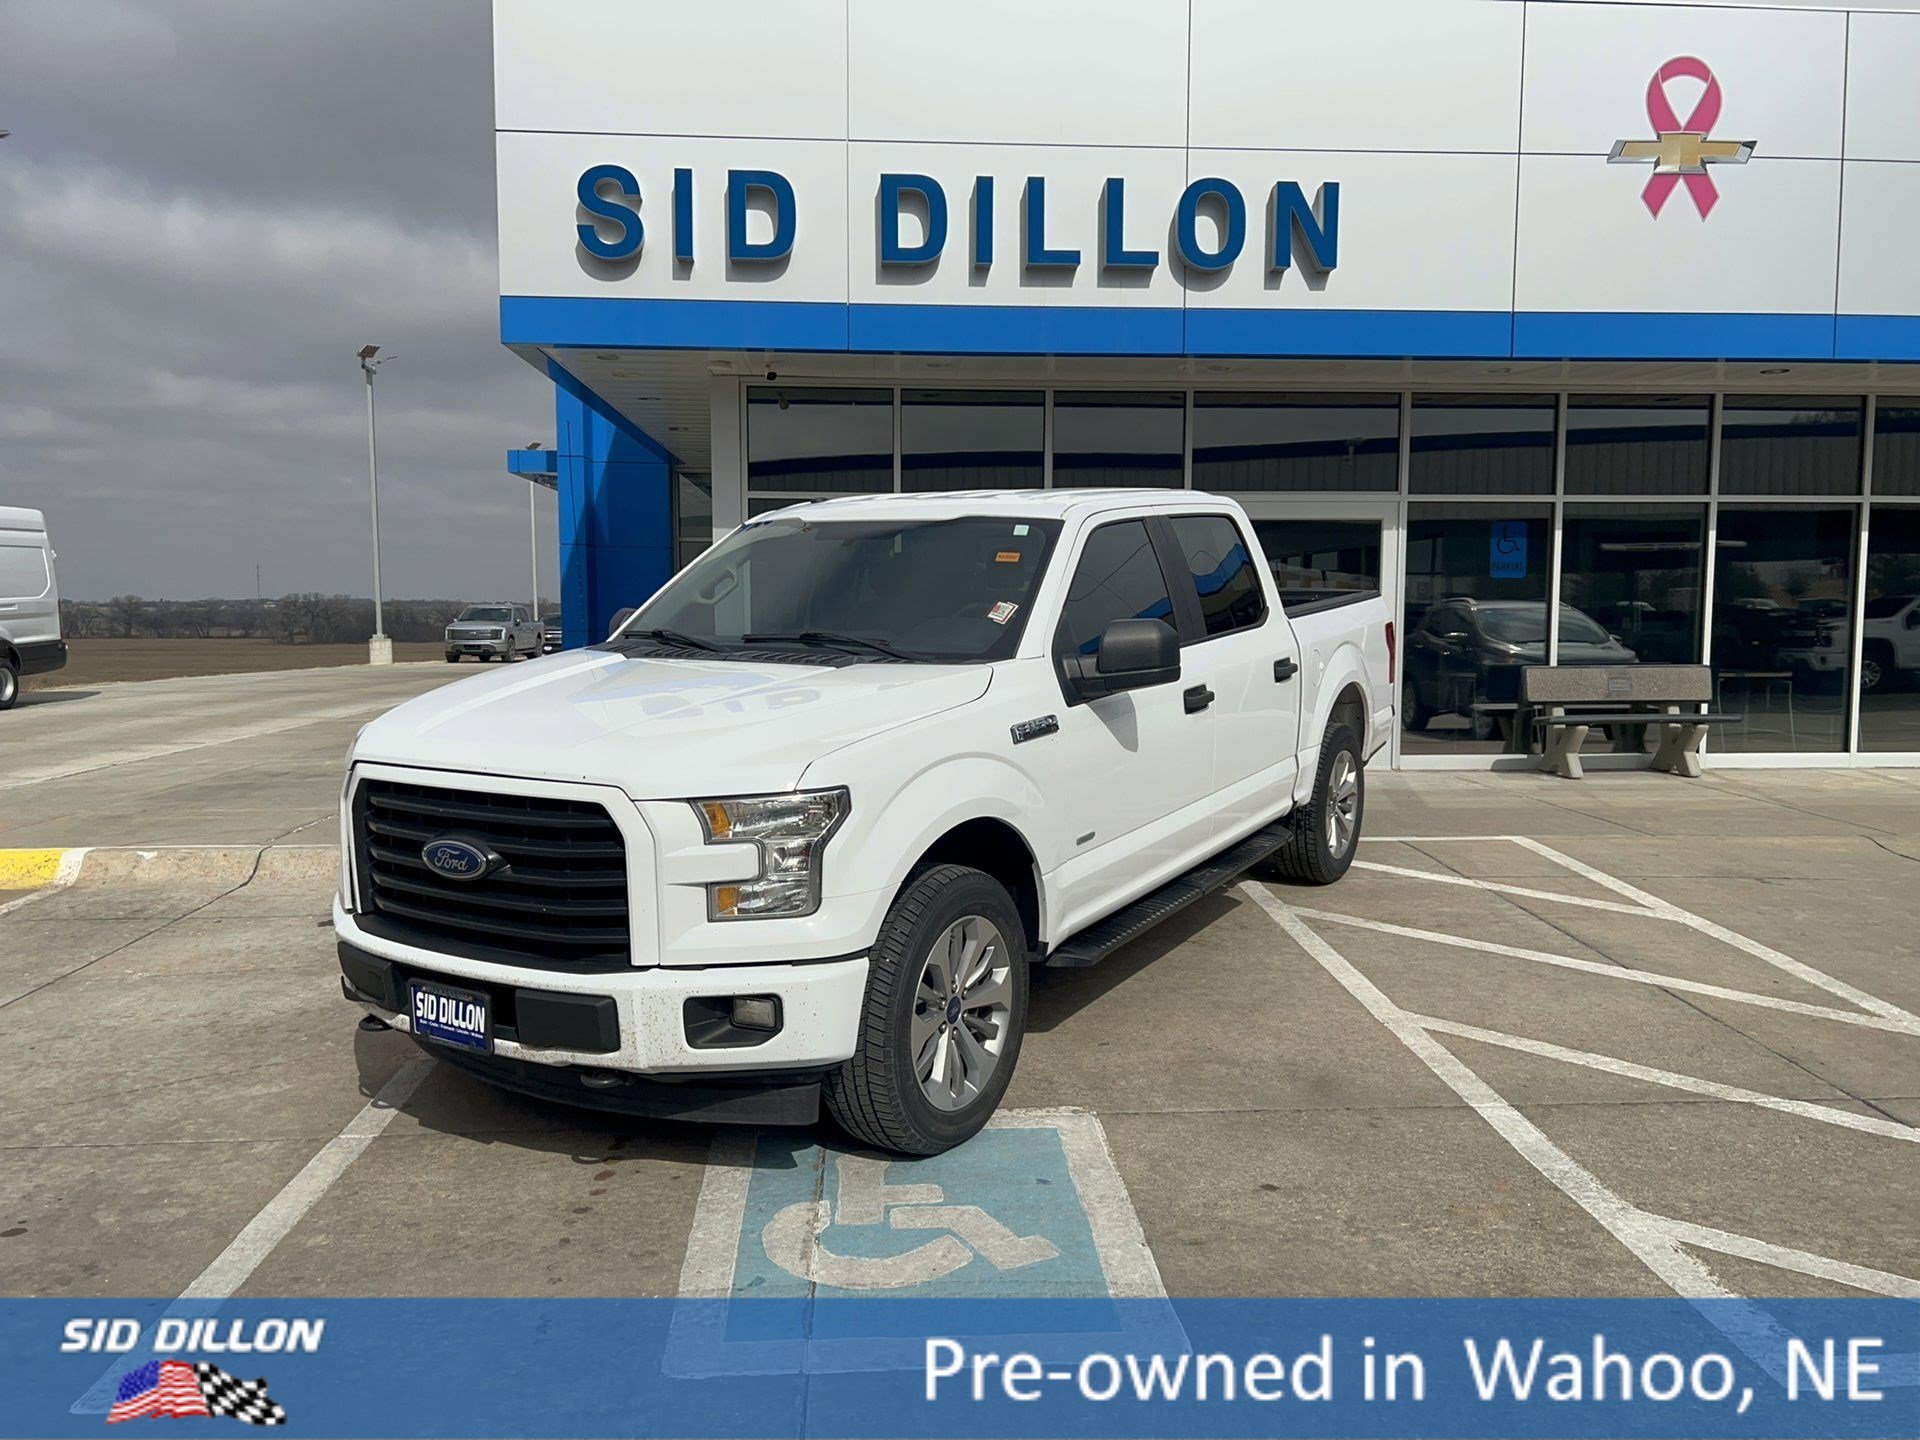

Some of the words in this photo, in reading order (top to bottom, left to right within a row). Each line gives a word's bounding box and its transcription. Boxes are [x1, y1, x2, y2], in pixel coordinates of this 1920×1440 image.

[577, 165, 797, 262] SID
[878, 173, 1340, 271] DILLON
[434, 847, 469, 871] Ford
[416, 991, 437, 1021] SID
[439, 996, 485, 1034] DILLON
